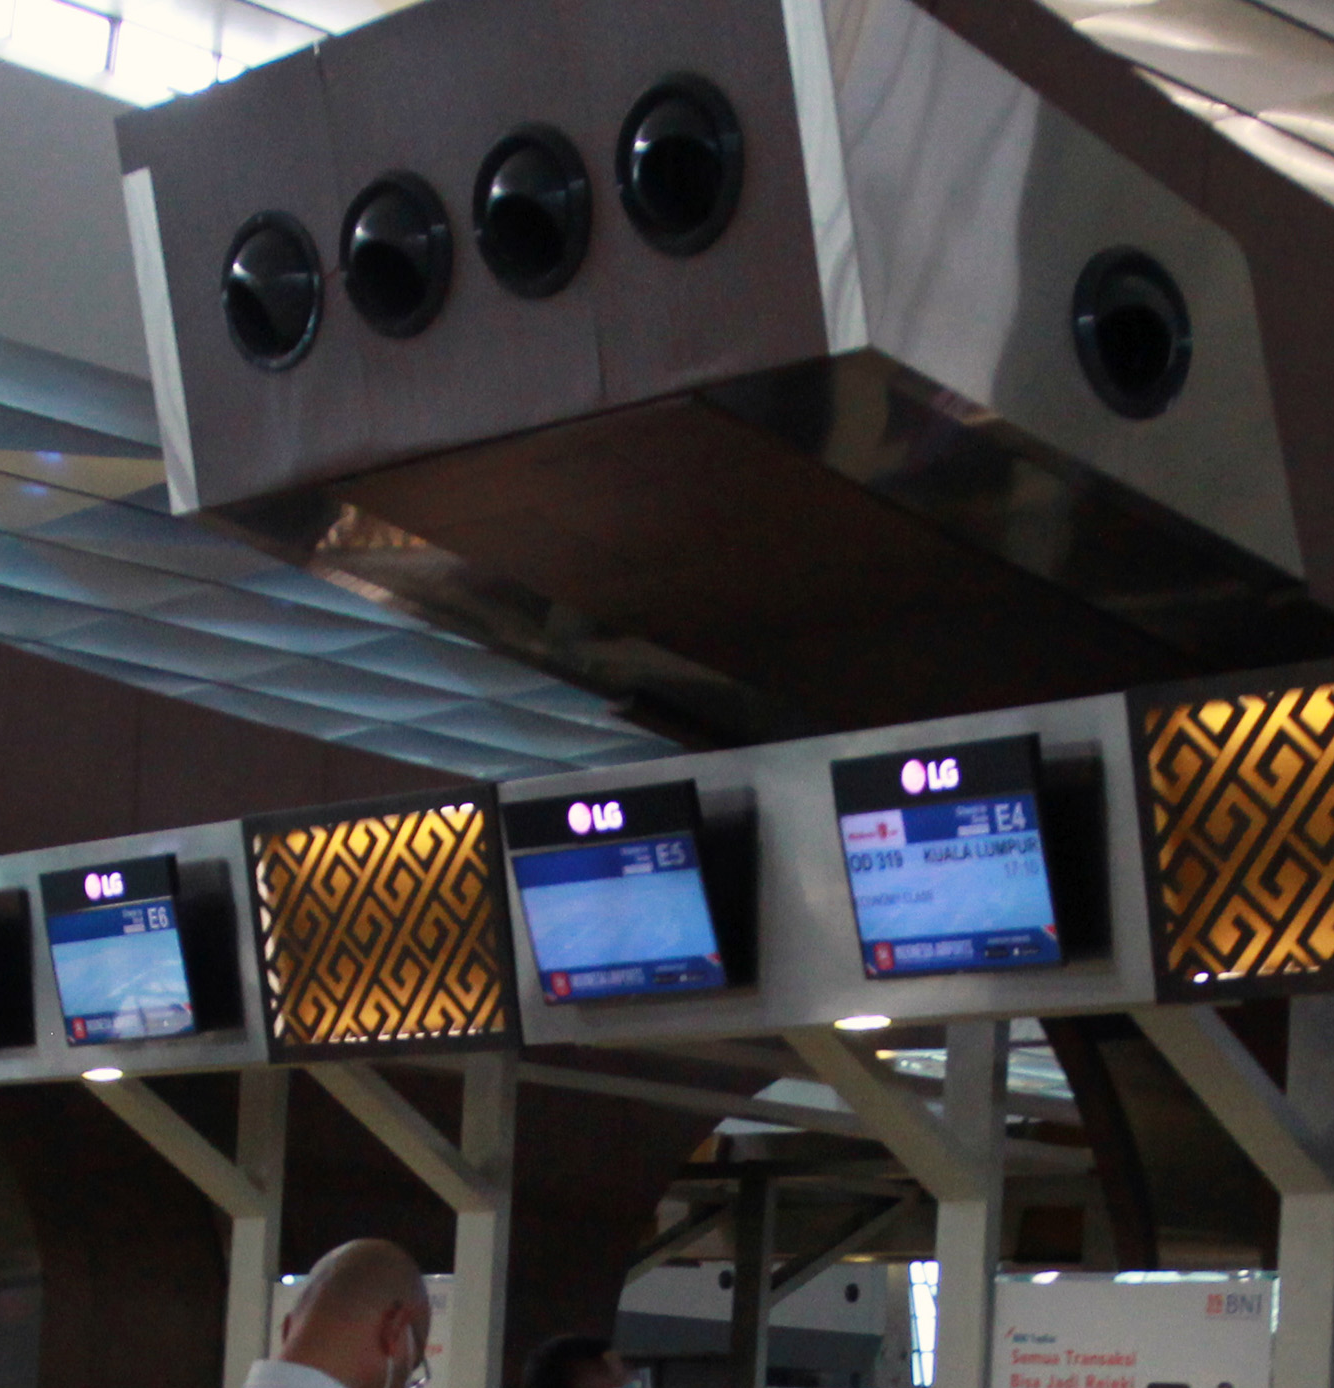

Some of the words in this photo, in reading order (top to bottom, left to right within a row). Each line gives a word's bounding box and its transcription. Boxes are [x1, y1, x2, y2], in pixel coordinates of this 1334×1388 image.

[927, 758, 959, 791] LG
[592, 800, 624, 831] LG
[994, 801, 1027, 833] E4
[923, 843, 970, 863] KUALA
[972, 837, 1037, 858] LUMPUR
[100, 872, 124, 897] LG
[147, 906, 169, 929] E6
[1225, 1294, 1262, 1315] BNI
[1011, 1348, 1061, 1365] Semua
[1064, 1349, 1137, 1367] Transaksi
